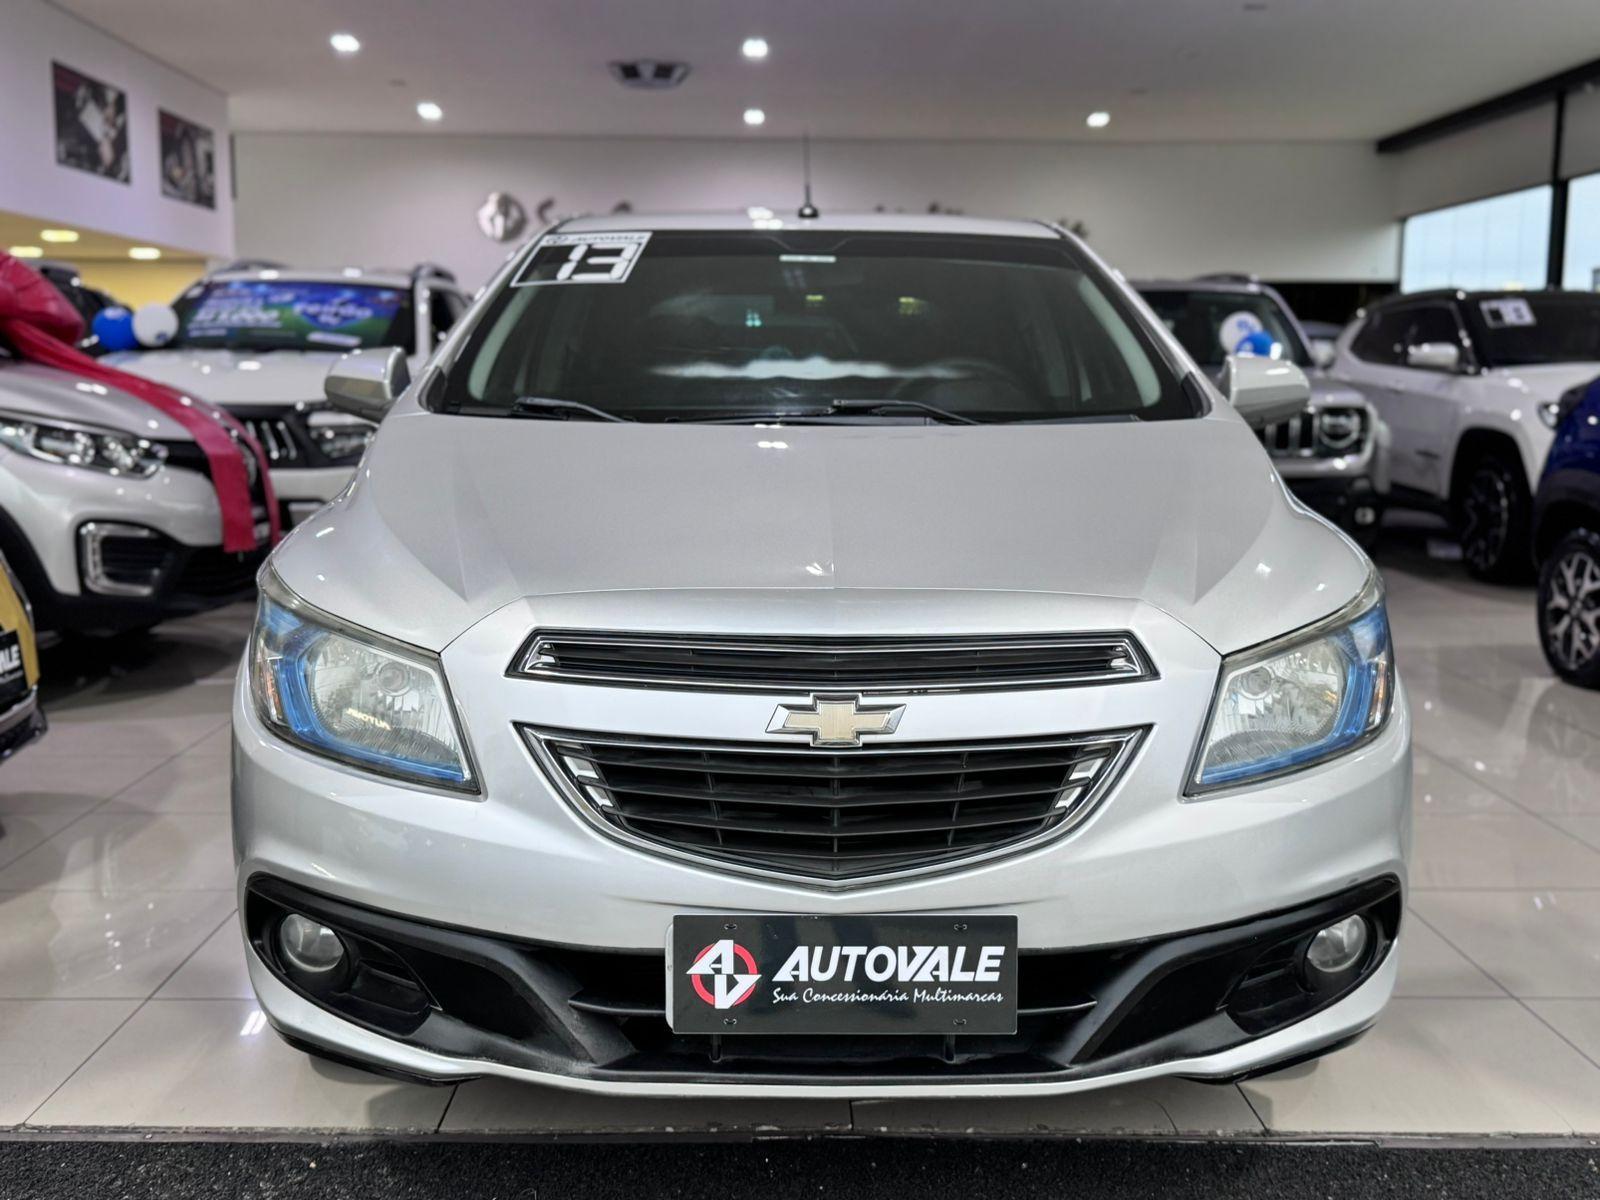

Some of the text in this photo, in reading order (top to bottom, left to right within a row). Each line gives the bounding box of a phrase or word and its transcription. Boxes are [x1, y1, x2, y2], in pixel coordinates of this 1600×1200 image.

[772, 945, 1005, 982] AUTOVALE
[772, 987, 799, 1004] Sua
[913, 987, 1004, 1003] Multimarcas
